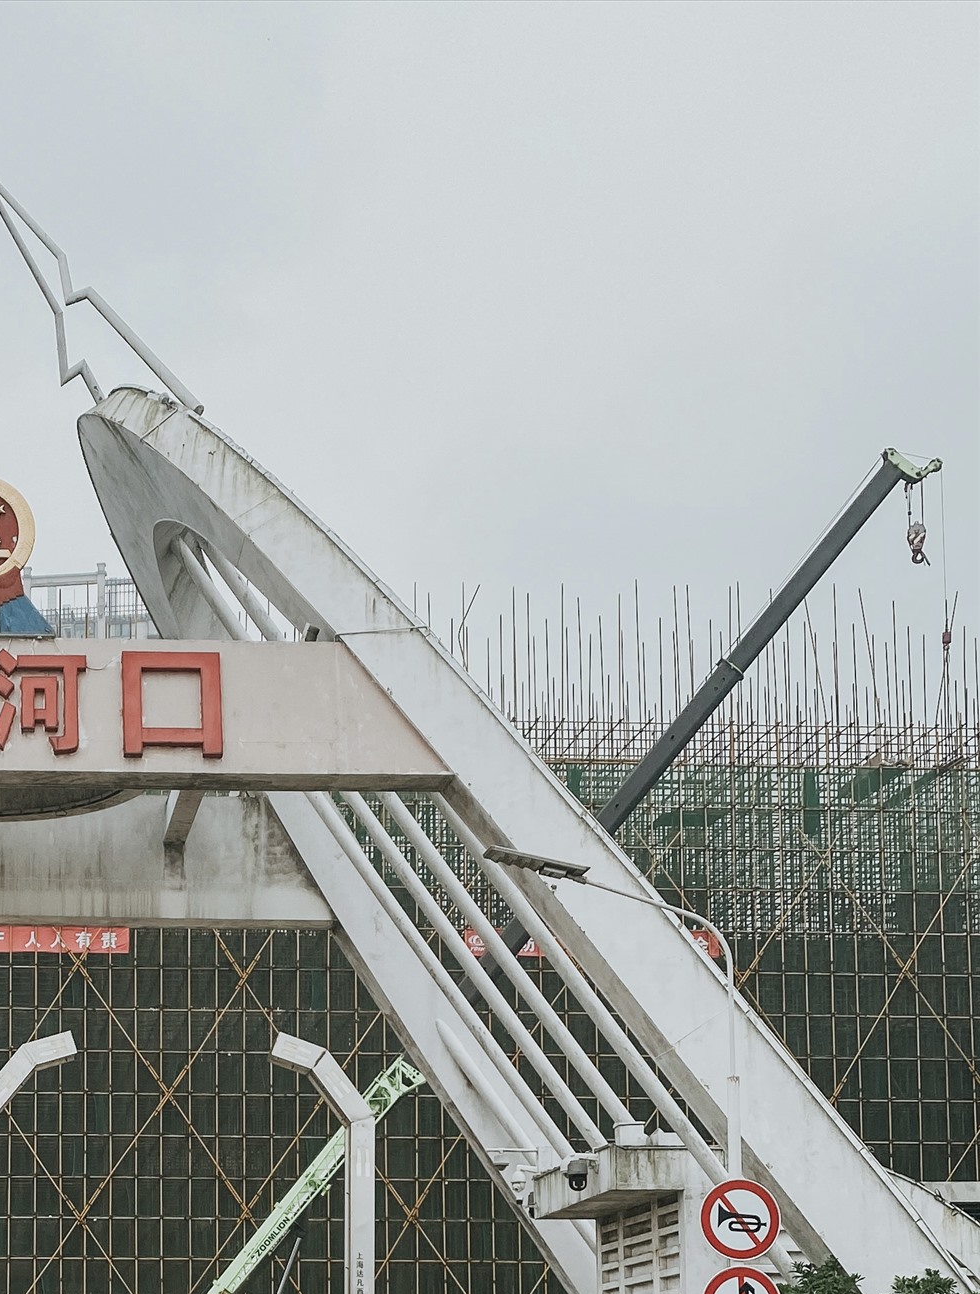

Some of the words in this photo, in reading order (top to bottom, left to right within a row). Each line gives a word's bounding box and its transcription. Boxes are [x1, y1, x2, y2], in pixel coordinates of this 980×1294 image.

[24, 930, 118, 949] 人人有责
[255, 1216, 291, 1257] ZOOMLION
